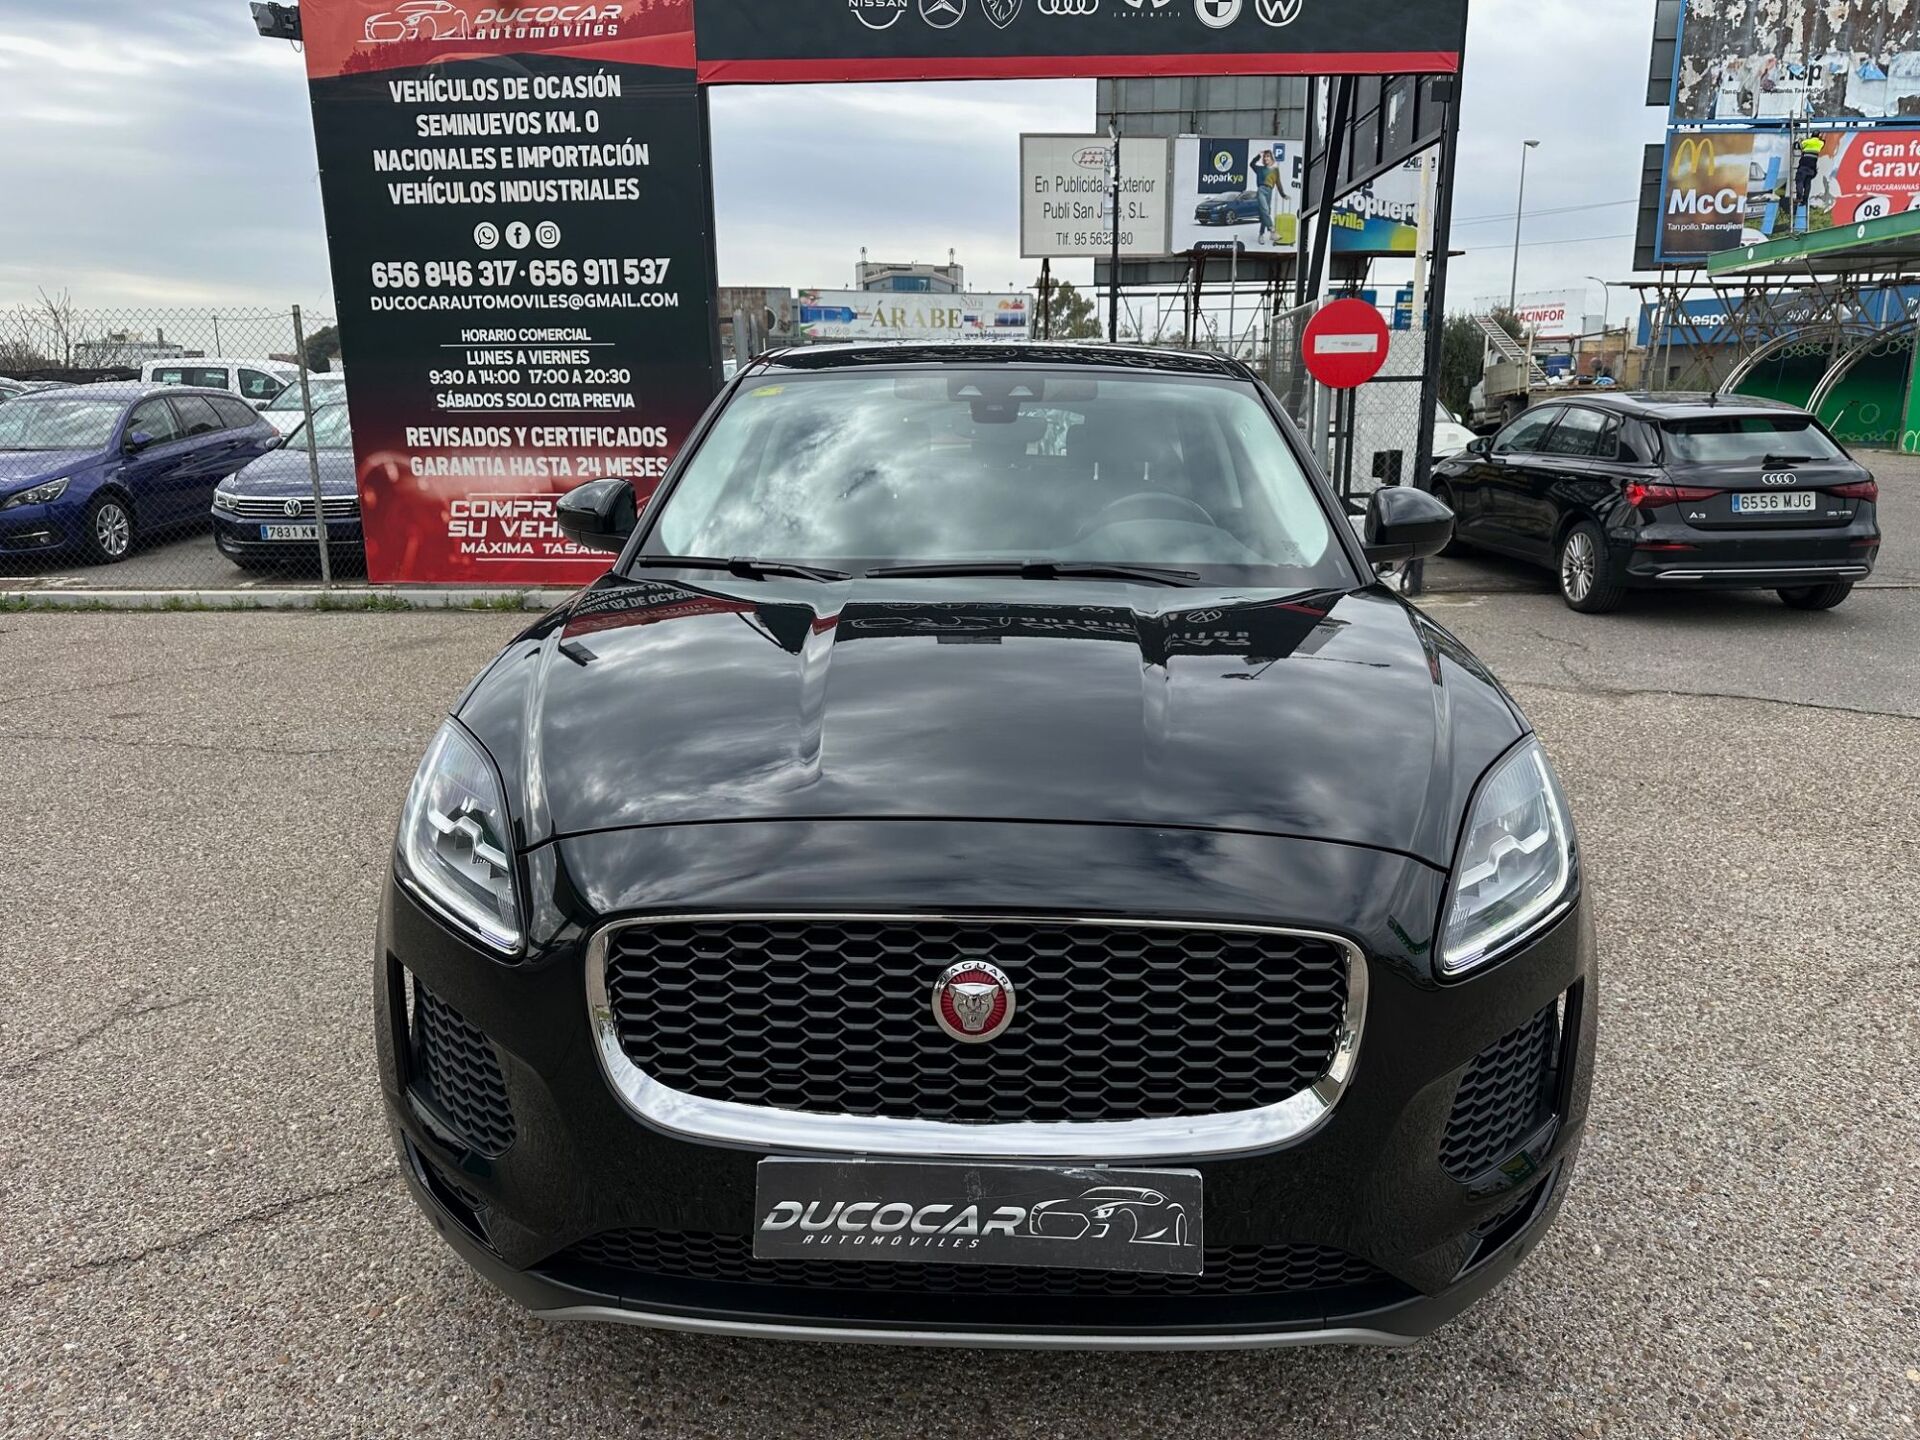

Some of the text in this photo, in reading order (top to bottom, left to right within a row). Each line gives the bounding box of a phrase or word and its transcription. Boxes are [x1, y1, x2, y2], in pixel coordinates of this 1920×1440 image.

[473, 3, 623, 24] DUCOCAR
[474, 22, 619, 41] automóviles
[388, 69, 622, 104] VEHÍCULOS DE OCASIÓN
[415, 112, 543, 137] SEMINUEVOS
[546, 111, 582, 134] KM.
[373, 138, 650, 172] NACIONALES E IMPORTACIÓN
[1862, 141, 1905, 158] Gran
[1858, 158, 1920, 178] Carav
[1034, 175, 1050, 193] En
[1117, 175, 1156, 193] Exterior
[1202, 172, 1244, 183] apparkya
[388, 177, 641, 205] VEHÍCULOS INDUSTRIALES
[1862, 183, 1920, 191] AUTOCARAVANAS
[1043, 202, 1071, 219] Publi
[1073, 201, 1095, 219] San
[1128, 201, 1150, 219] S.L.
[1863, 204, 1881, 217] 08
[1331, 212, 1365, 231] evilla
[1667, 222, 1680, 231] Tan
[1680, 222, 1700, 232] pollo.
[1701, 222, 1715, 231] Tan
[1055, 232, 1071, 246] Tlf.
[1074, 231, 1088, 246] 95
[370, 260, 420, 289] 656
[424, 260, 474, 288] 846
[477, 259, 518, 287] 317
[528, 259, 578, 287] 656
[583, 259, 619, 285] 911
[623, 257, 671, 285] 537
[370, 292, 680, 311] DUCOCARAUTOMOVILES@GMAIL.COM
[870, 300, 964, 329] ÁRABE
[461, 327, 592, 342] HORARIO COMERCIAL
[466, 350, 590, 366] LUNES A VIERNES
[429, 368, 632, 385] 9:30 A 14:00 17:00 A 20:30
[436, 390, 635, 409] SÁBADOS SOLO CITA PREVIA
[405, 426, 669, 449] REVISADOS Y CERTIFICADOS
[410, 456, 668, 478] GARANTIA HASTA 24 MESES
[450, 499, 558, 519] COMPR
[1741, 493, 1812, 510] 6556 MJG
[1689, 511, 1707, 520] A3
[269, 526, 298, 538] 7831
[447, 520, 488, 538] SU
[460, 540, 534, 554] MÁXIMA
[939, 962, 1009, 987] JAGUAR
[760, 1200, 1027, 1237] DUCOCAR
[802, 1234, 981, 1249] AUTOMÓVILES
